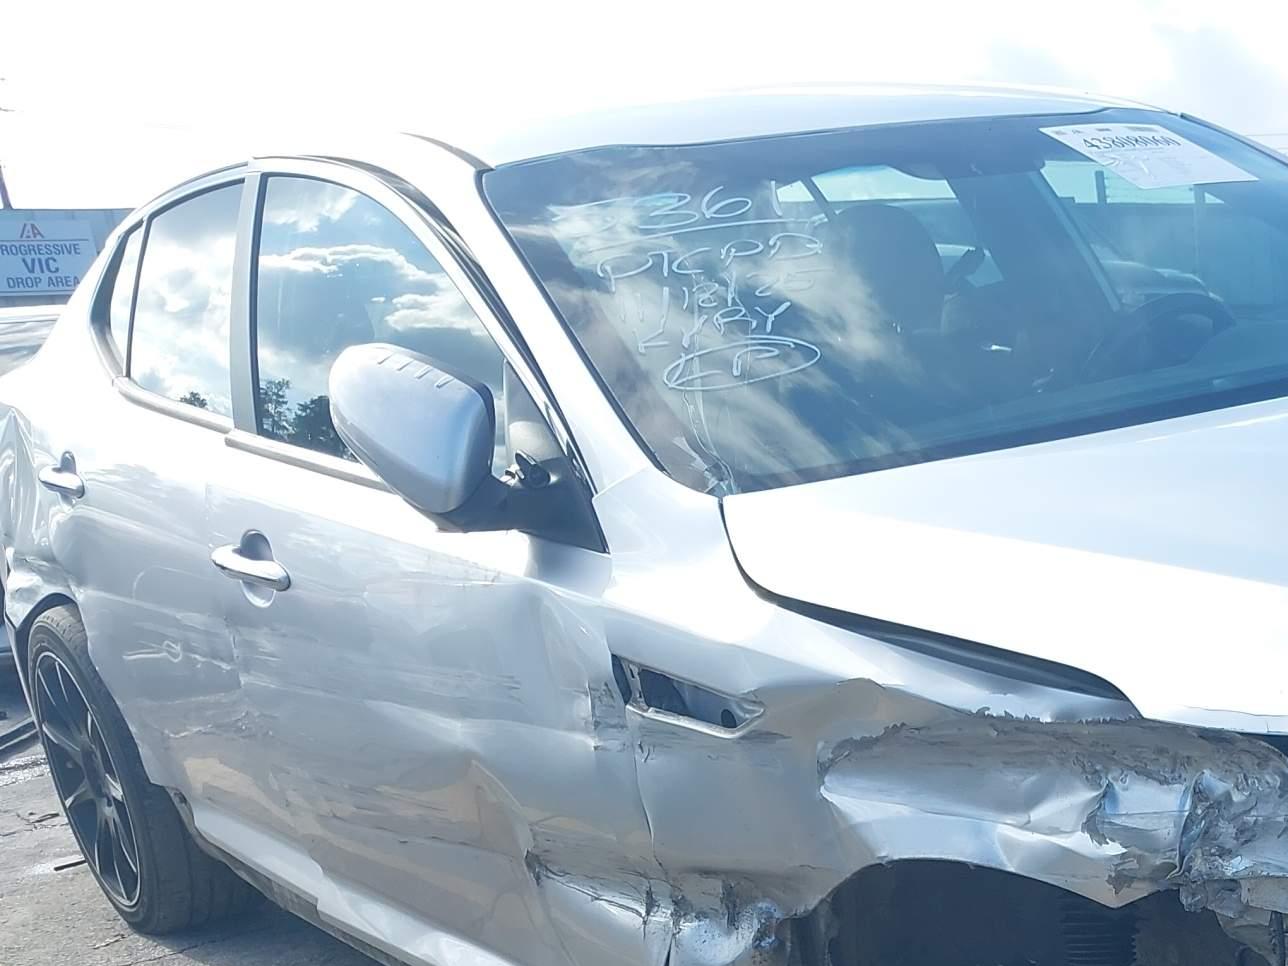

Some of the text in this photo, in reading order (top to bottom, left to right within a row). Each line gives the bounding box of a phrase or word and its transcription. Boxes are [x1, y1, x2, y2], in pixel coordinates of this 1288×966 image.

[0, 243, 81, 256] ROGRESSIVE
[22, 257, 60, 274] VIC
[7, 276, 80, 289] DROP AREA
